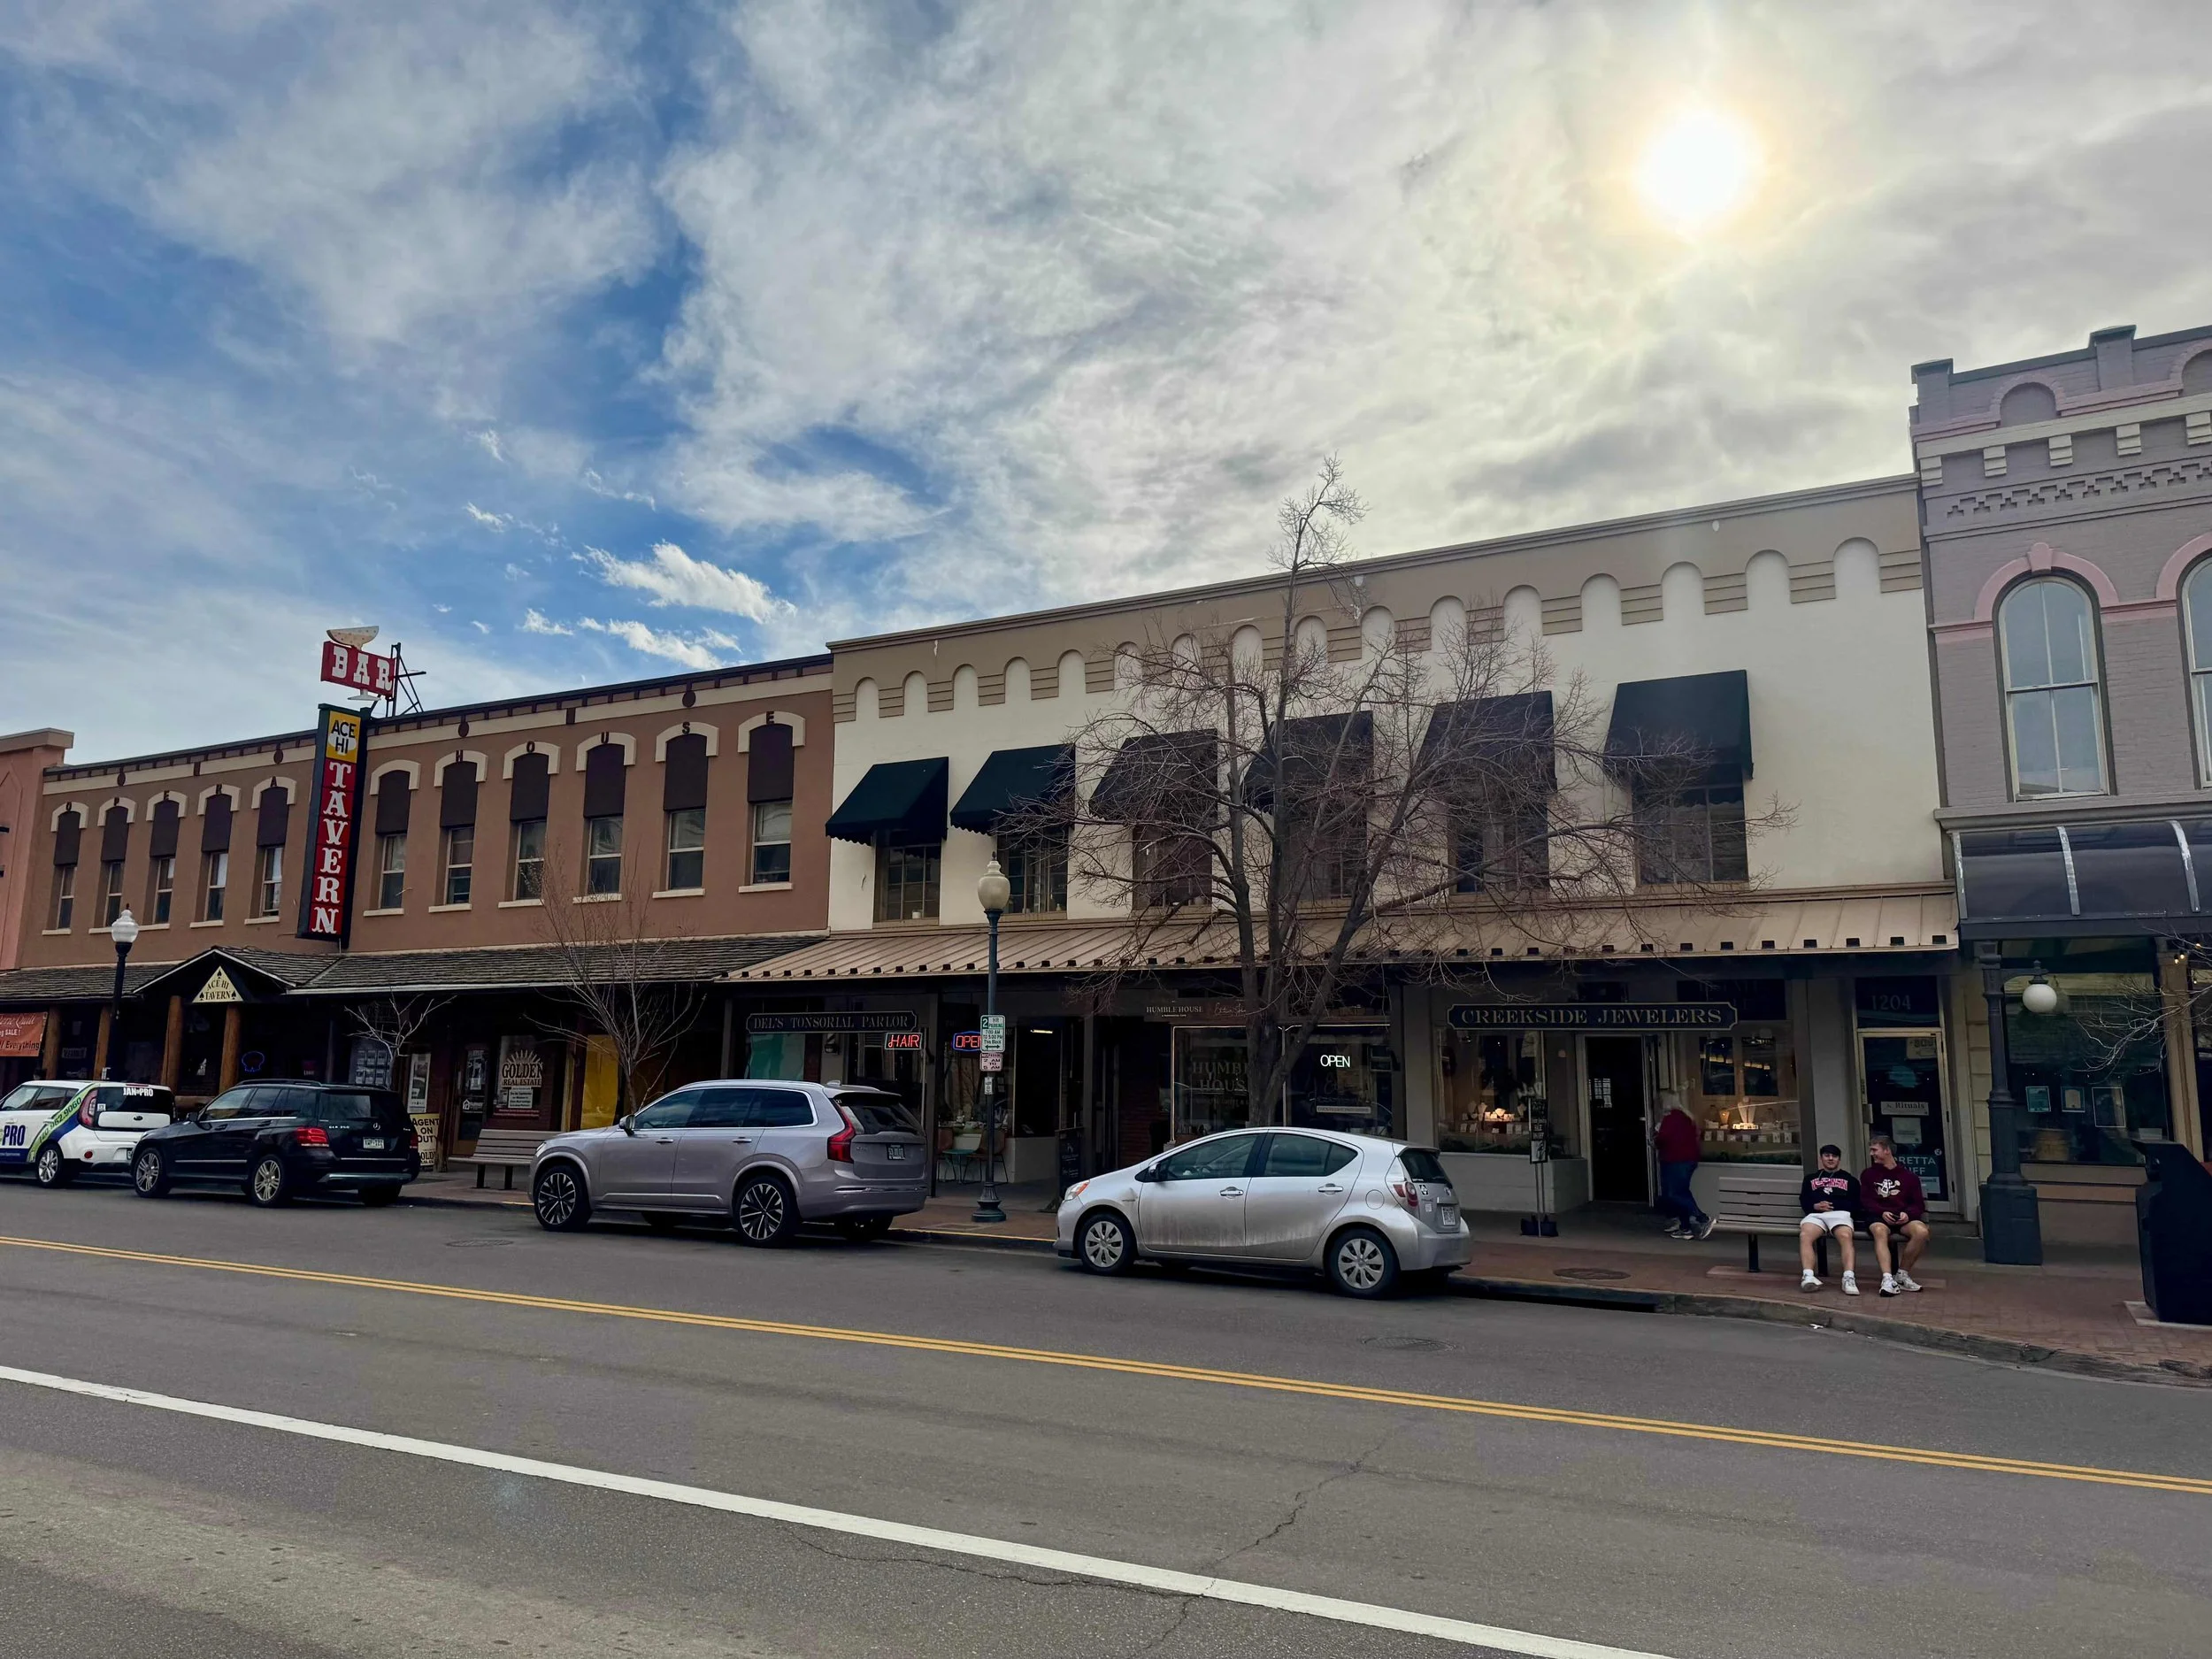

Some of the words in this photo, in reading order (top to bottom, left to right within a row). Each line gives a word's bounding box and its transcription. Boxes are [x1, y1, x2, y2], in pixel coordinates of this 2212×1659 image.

[332, 645, 393, 691] BAR
[331, 719, 357, 738] ACE
[334, 736, 349, 755] HI
[311, 762, 352, 934] TAVERN
[207, 979, 220, 991] ACE
[221, 979, 230, 989] HI
[204, 991, 231, 1000] TAVERN
[1871, 995, 1911, 1010] 1204
[754, 1018, 784, 1029] DEL'S
[790, 1017, 855, 1028] TONSORIAL
[862, 1015, 908, 1027] PARLOR
[983, 1018, 988, 1028] 2
[1462, 1010, 1587, 1024] CREEKSIDE
[1596, 1009, 1722, 1024] JEWELERS
[5, 1041, 40, 1050] Everything
[887, 1034, 920, 1048] HAIR
[1320, 1054, 1351, 1068] OPEN
[502, 1063, 543, 1079] GOLDEN
[1200, 1079, 1246, 1092] HOUS
